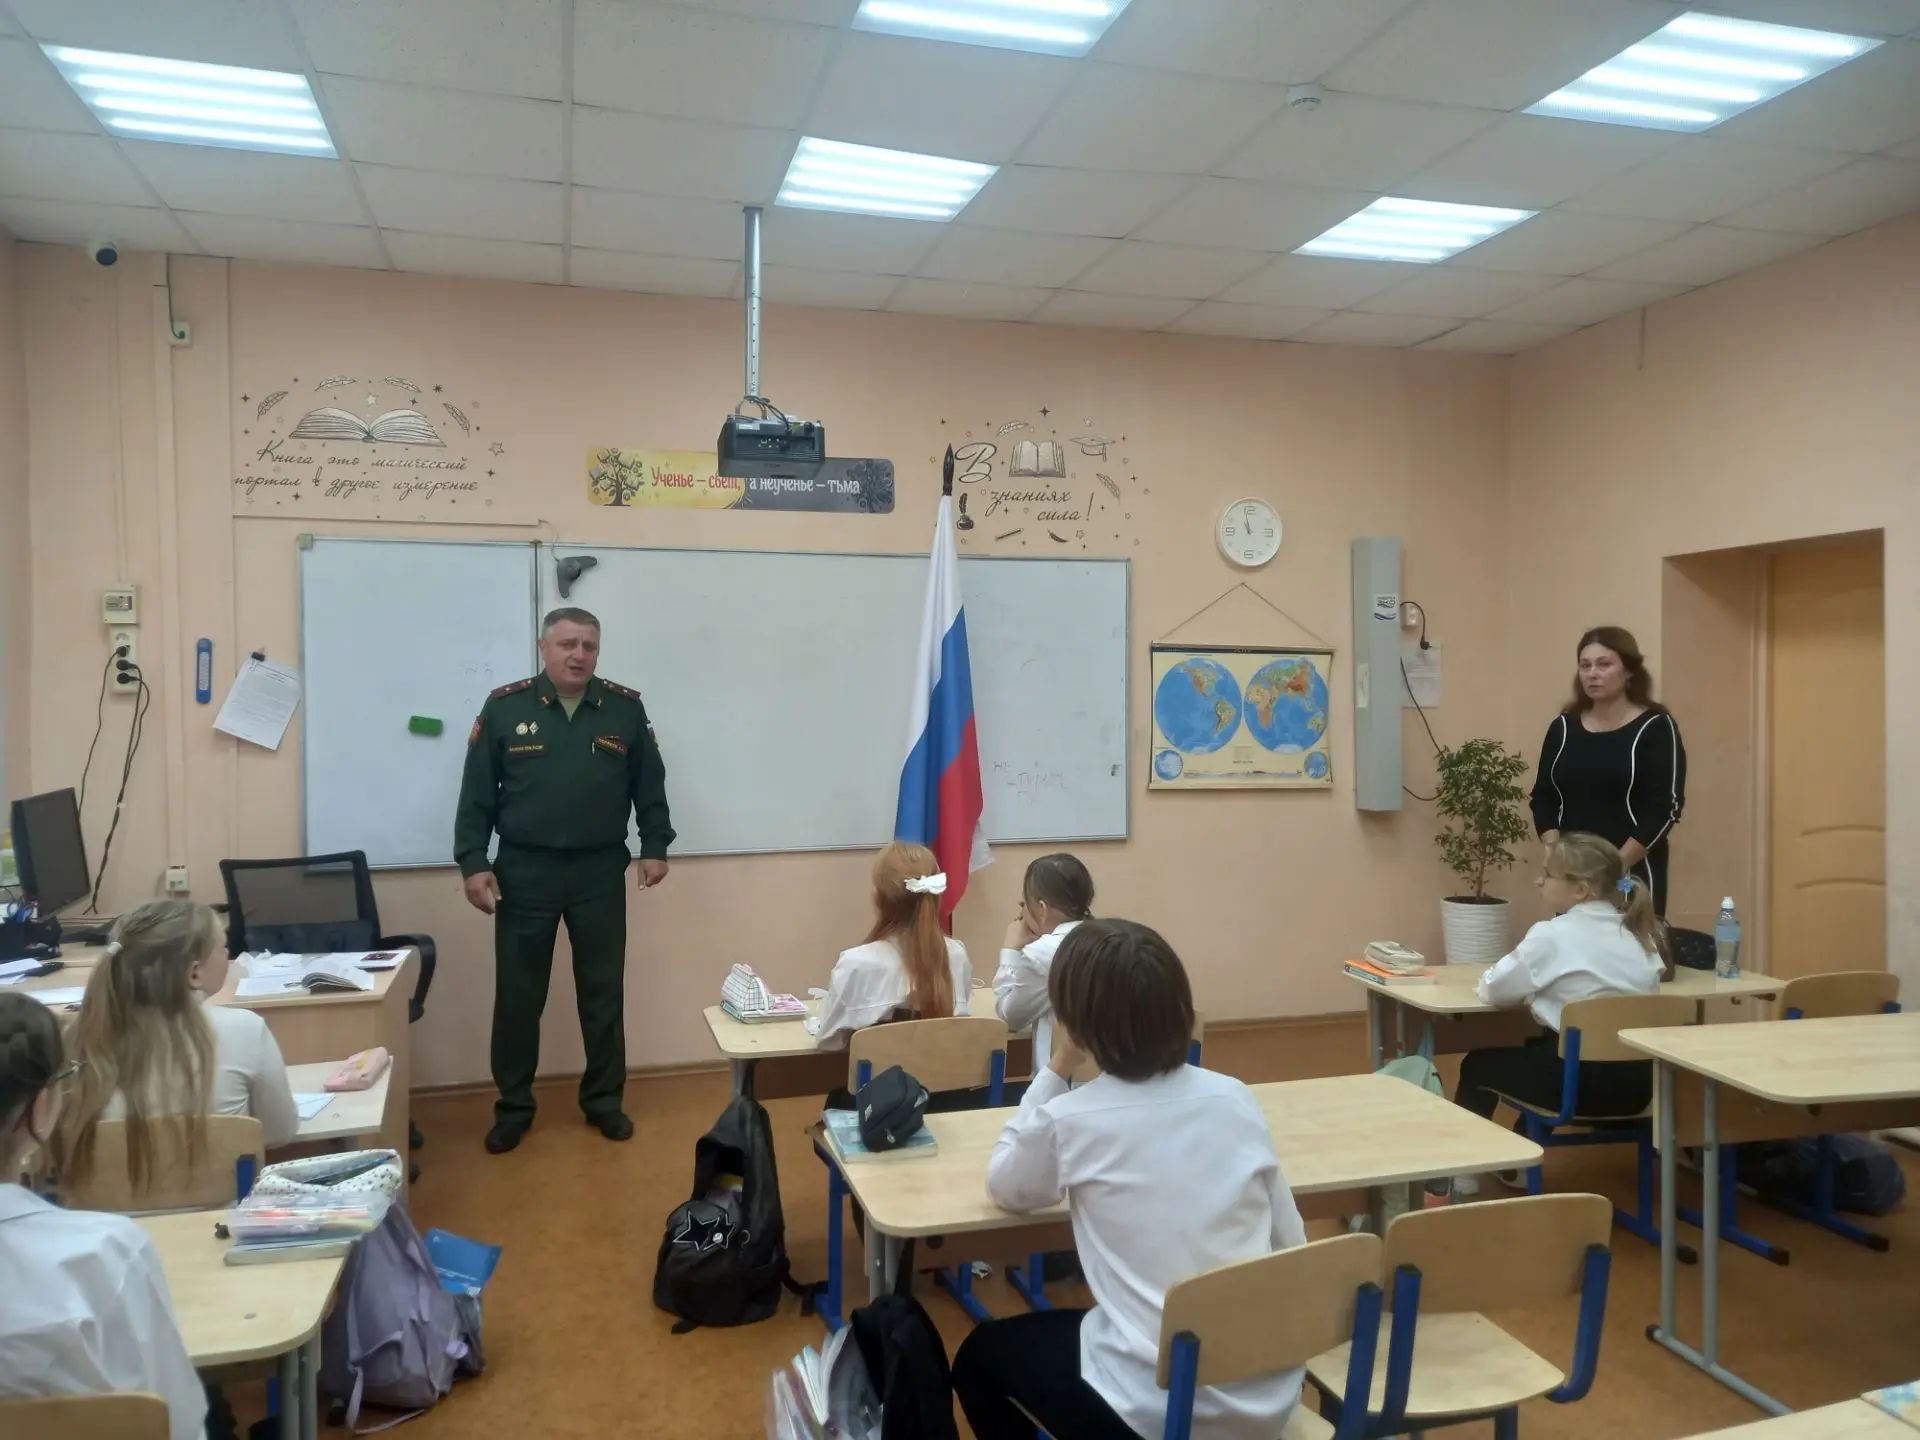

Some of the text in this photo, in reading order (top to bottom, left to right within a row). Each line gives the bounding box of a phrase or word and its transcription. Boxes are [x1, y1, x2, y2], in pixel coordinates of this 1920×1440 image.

[257, 440, 468, 470] Книга это магический
[954, 442, 997, 483] В
[234, 466, 478, 501] портал в другое измерение
[650, 466, 694, 488] Ученье
[749, 478, 757, 490] а
[760, 478, 814, 496] неученье
[827, 479, 860, 494] тьма
[984, 491, 1072, 517] знаниях
[1225, 527, 1235, 537] 9
[1262, 528, 1273, 538] 3
[1243, 550, 1253, 559] 6
